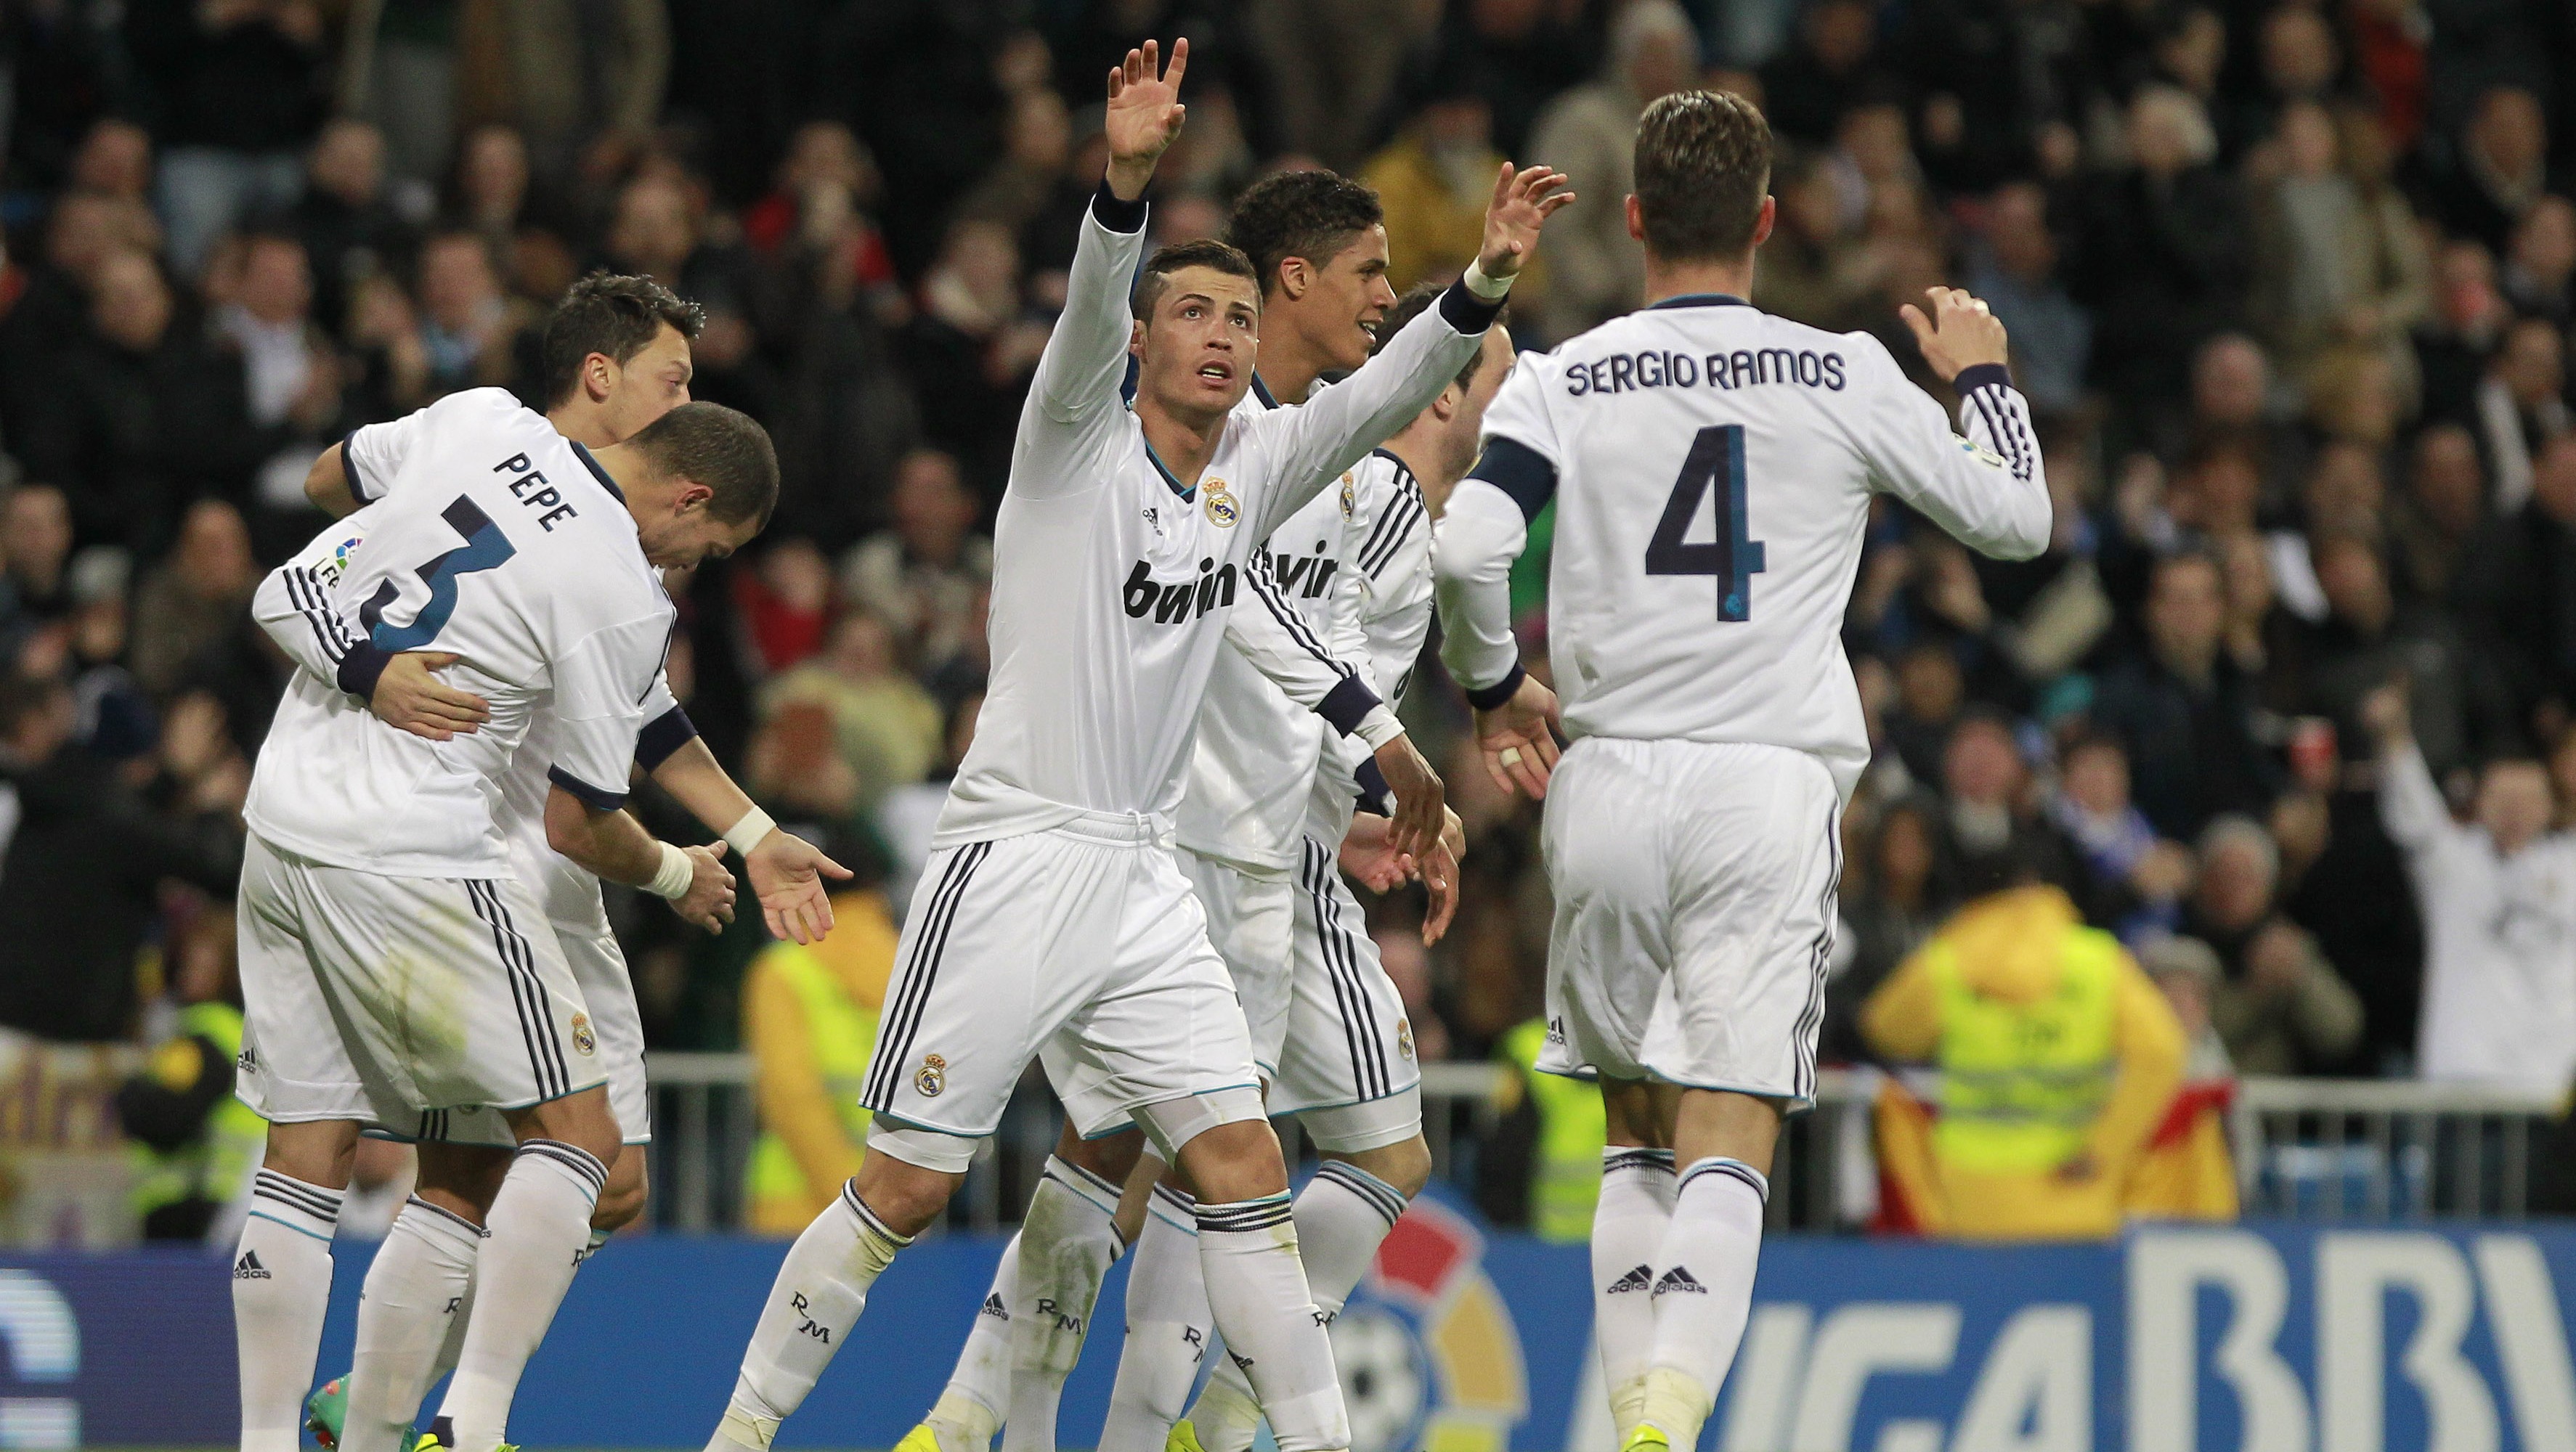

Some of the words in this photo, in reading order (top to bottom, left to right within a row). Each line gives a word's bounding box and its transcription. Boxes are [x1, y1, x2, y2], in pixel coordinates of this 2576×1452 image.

[1567, 348, 1699, 396] SERGIO
[1707, 348, 1846, 391] RAMOS
[493, 452, 578, 532] PEPE
[1646, 424, 1766, 621] 4
[359, 493, 518, 652] 3
[1124, 557, 1237, 624] bwin
